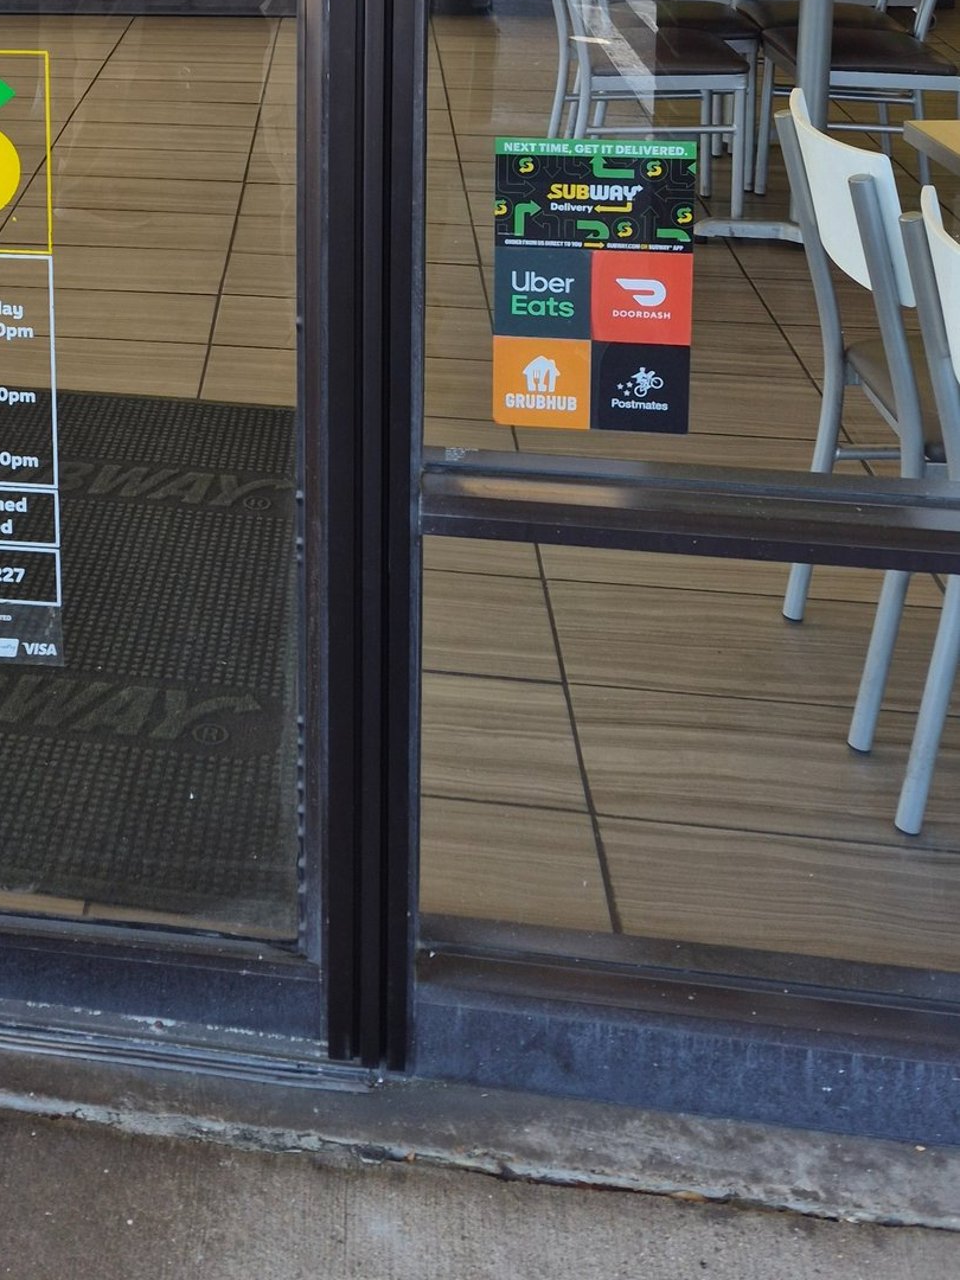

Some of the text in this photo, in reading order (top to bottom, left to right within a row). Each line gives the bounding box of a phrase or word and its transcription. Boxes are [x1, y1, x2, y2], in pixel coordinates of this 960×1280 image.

[504, 142, 688, 156] NEXT TIME, GET IT DELIVERED.
[546, 183, 644, 201] SUBWAY
[550, 202, 594, 214] Delivery
[511, 271, 575, 294] Uber
[511, 295, 575, 318] Eats
[612, 309, 671, 320] DOORDASH
[505, 392, 578, 412] GRUBHUB
[611, 398, 669, 411] Postmates
[22, 642, 57, 657] VISA
